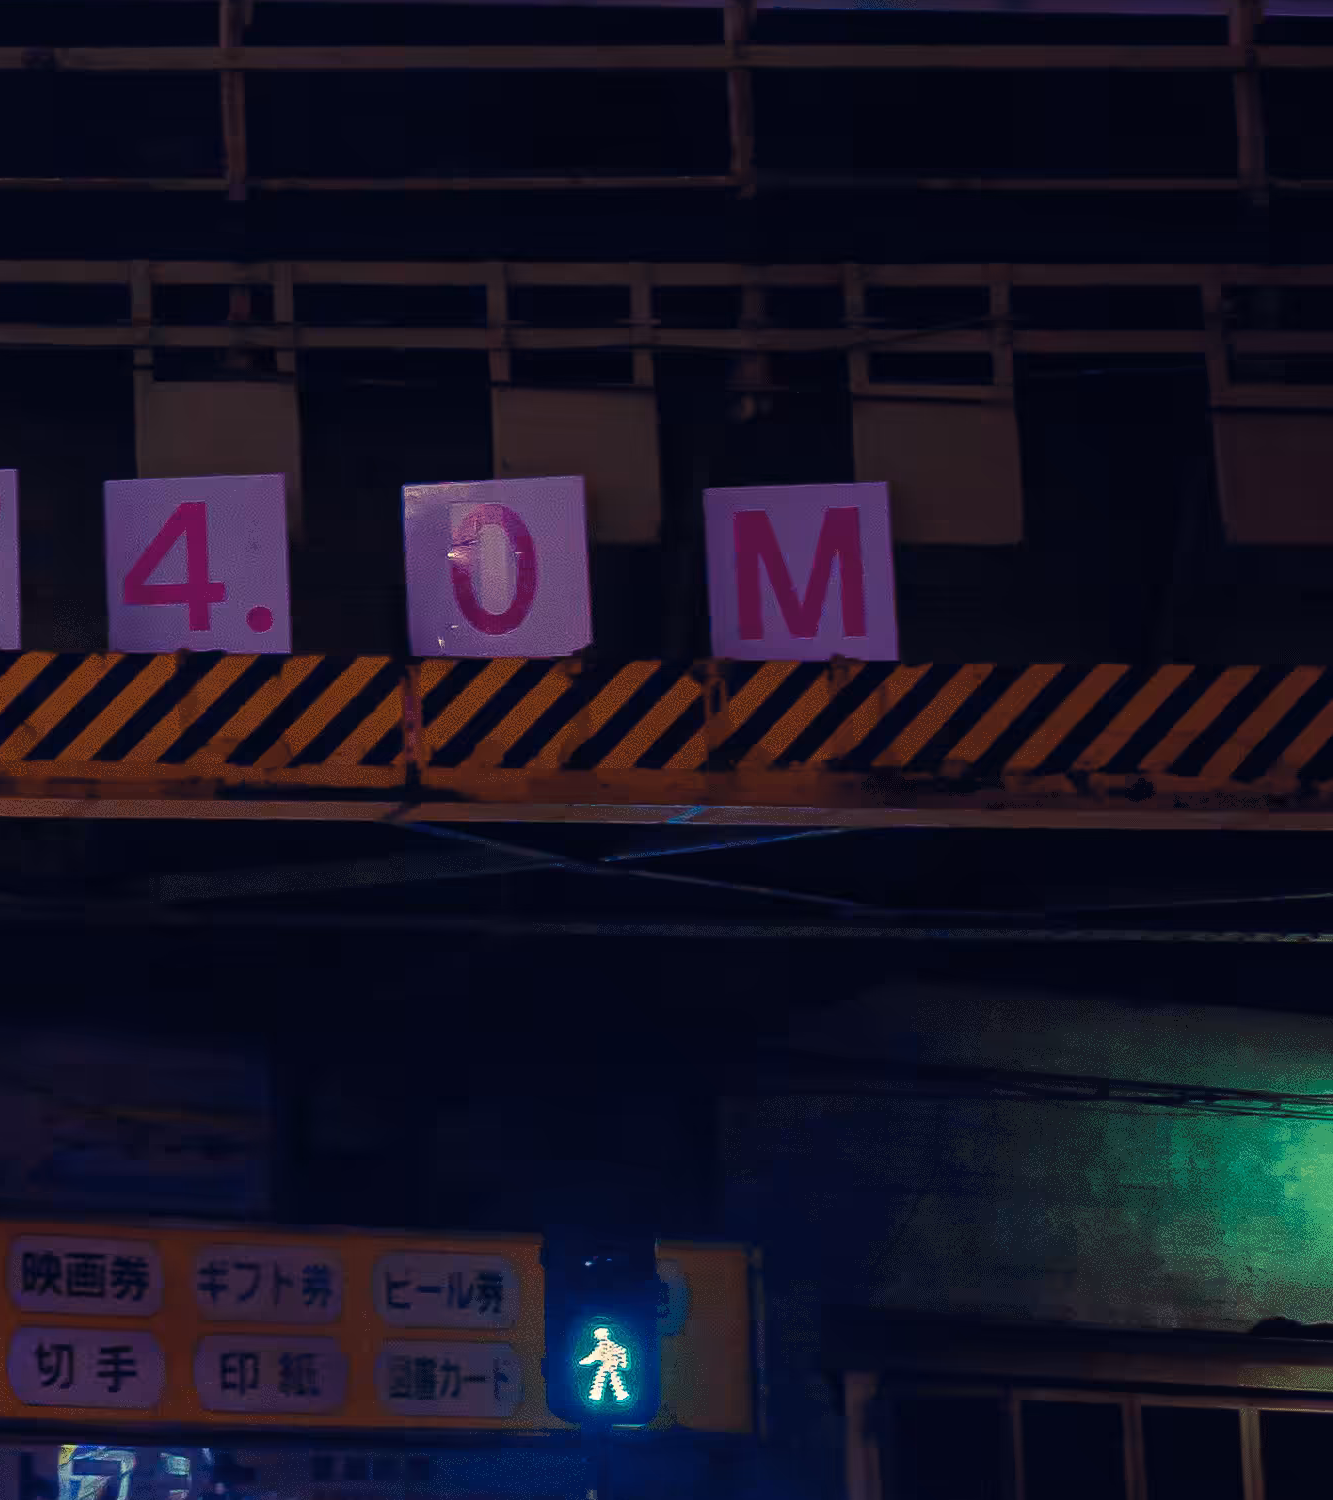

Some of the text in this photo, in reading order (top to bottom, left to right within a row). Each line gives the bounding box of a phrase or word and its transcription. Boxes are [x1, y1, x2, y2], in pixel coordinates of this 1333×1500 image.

[21, 1251, 149, 1302] 映画券
[196, 1258, 333, 1309] ギフト券
[383, 1270, 506, 1316] ビール券
[35, 1345, 138, 1393] 切手
[219, 1351, 324, 1396] 印紙
